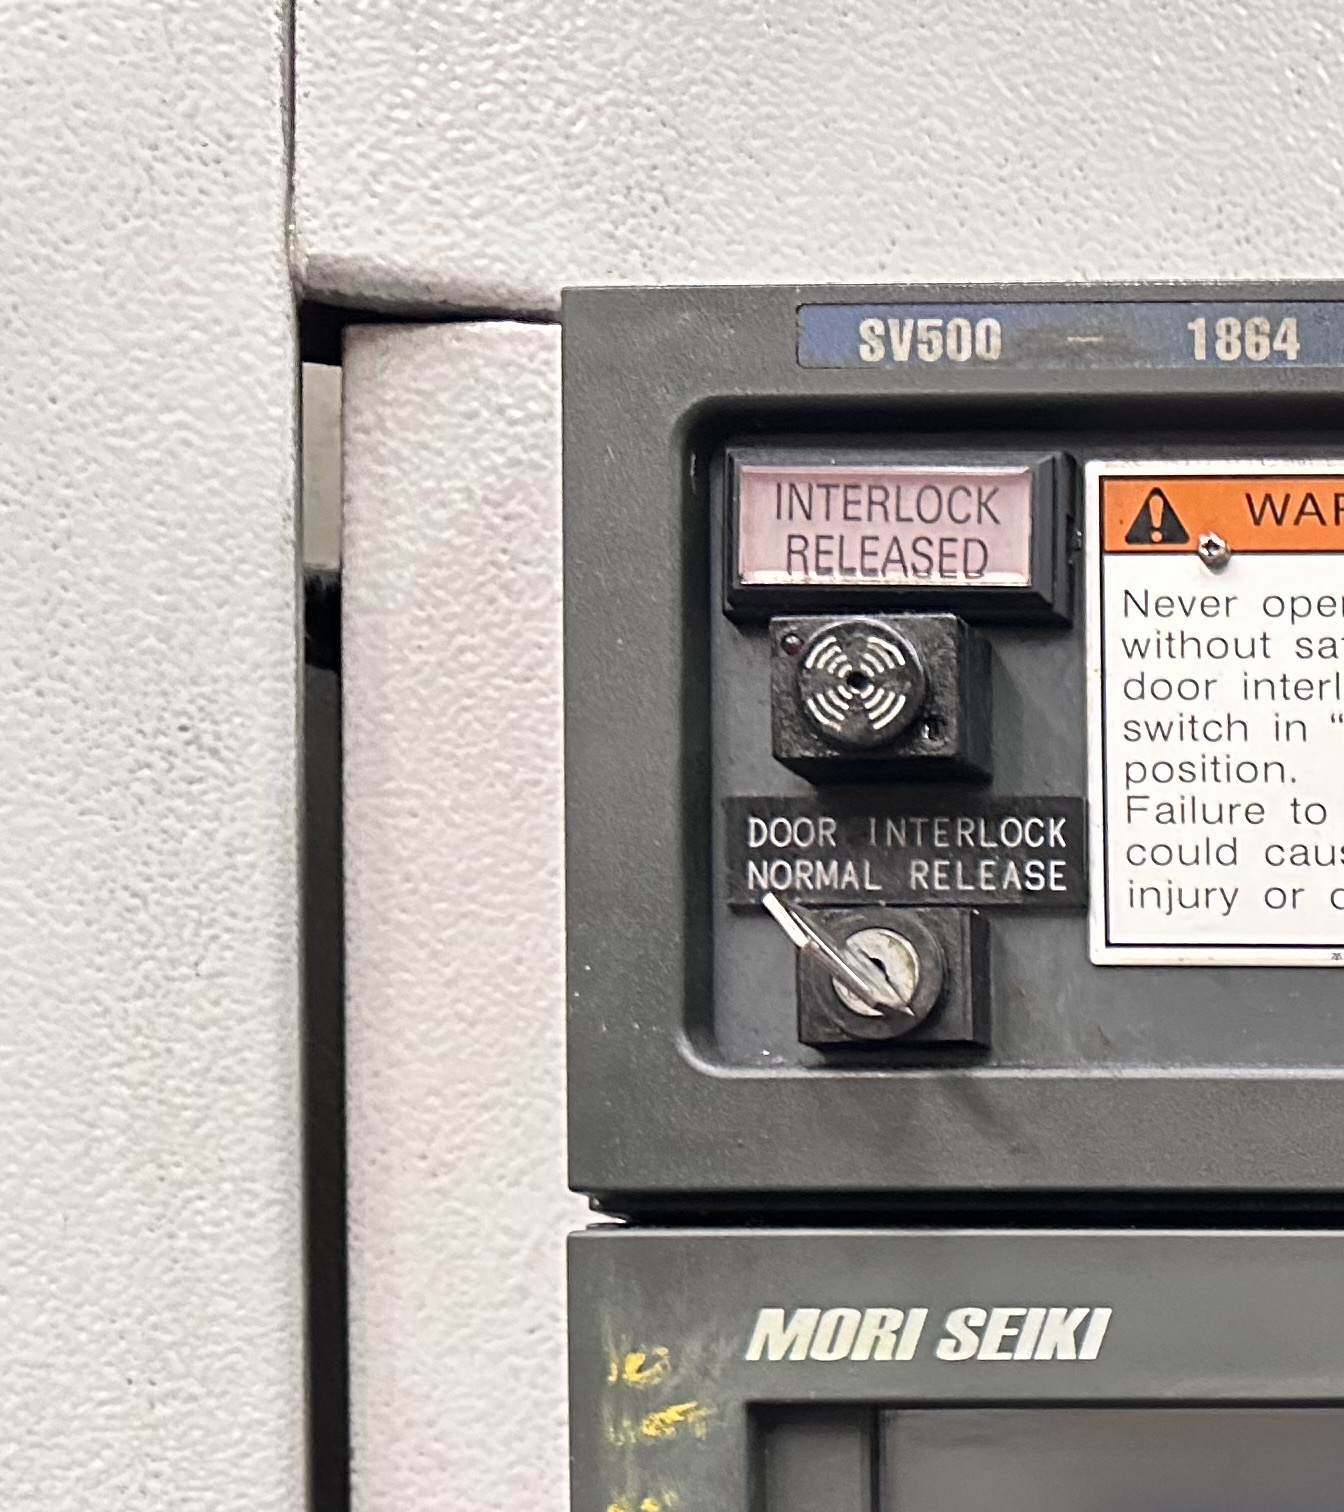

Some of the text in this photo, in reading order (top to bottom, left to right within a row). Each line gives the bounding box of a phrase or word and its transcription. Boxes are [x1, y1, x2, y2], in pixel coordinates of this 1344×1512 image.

[859, 318, 1001, 361] SV500
[1188, 317, 1301, 361] 1864
[774, 480, 1001, 525] INTERLOCK
[786, 533, 989, 580] RELEASED
[1123, 589, 1238, 618] Never
[1121, 630, 1271, 660] without
[1123, 671, 1218, 701] door
[1123, 712, 1248, 743] switch
[1274, 712, 1307, 742] in
[1125, 753, 1296, 790] position.
[1126, 795, 1265, 825] Failure
[1290, 797, 1327, 826] to
[746, 818, 1066, 848] DOOR INTERLOCK
[1126, 836, 1237, 867] could
[746, 860, 1066, 891] NORMAL RELEASE
[1129, 879, 1239, 917] injury
[1264, 886, 1305, 910] or
[745, 1306, 1112, 1362] MORI SEIKI
